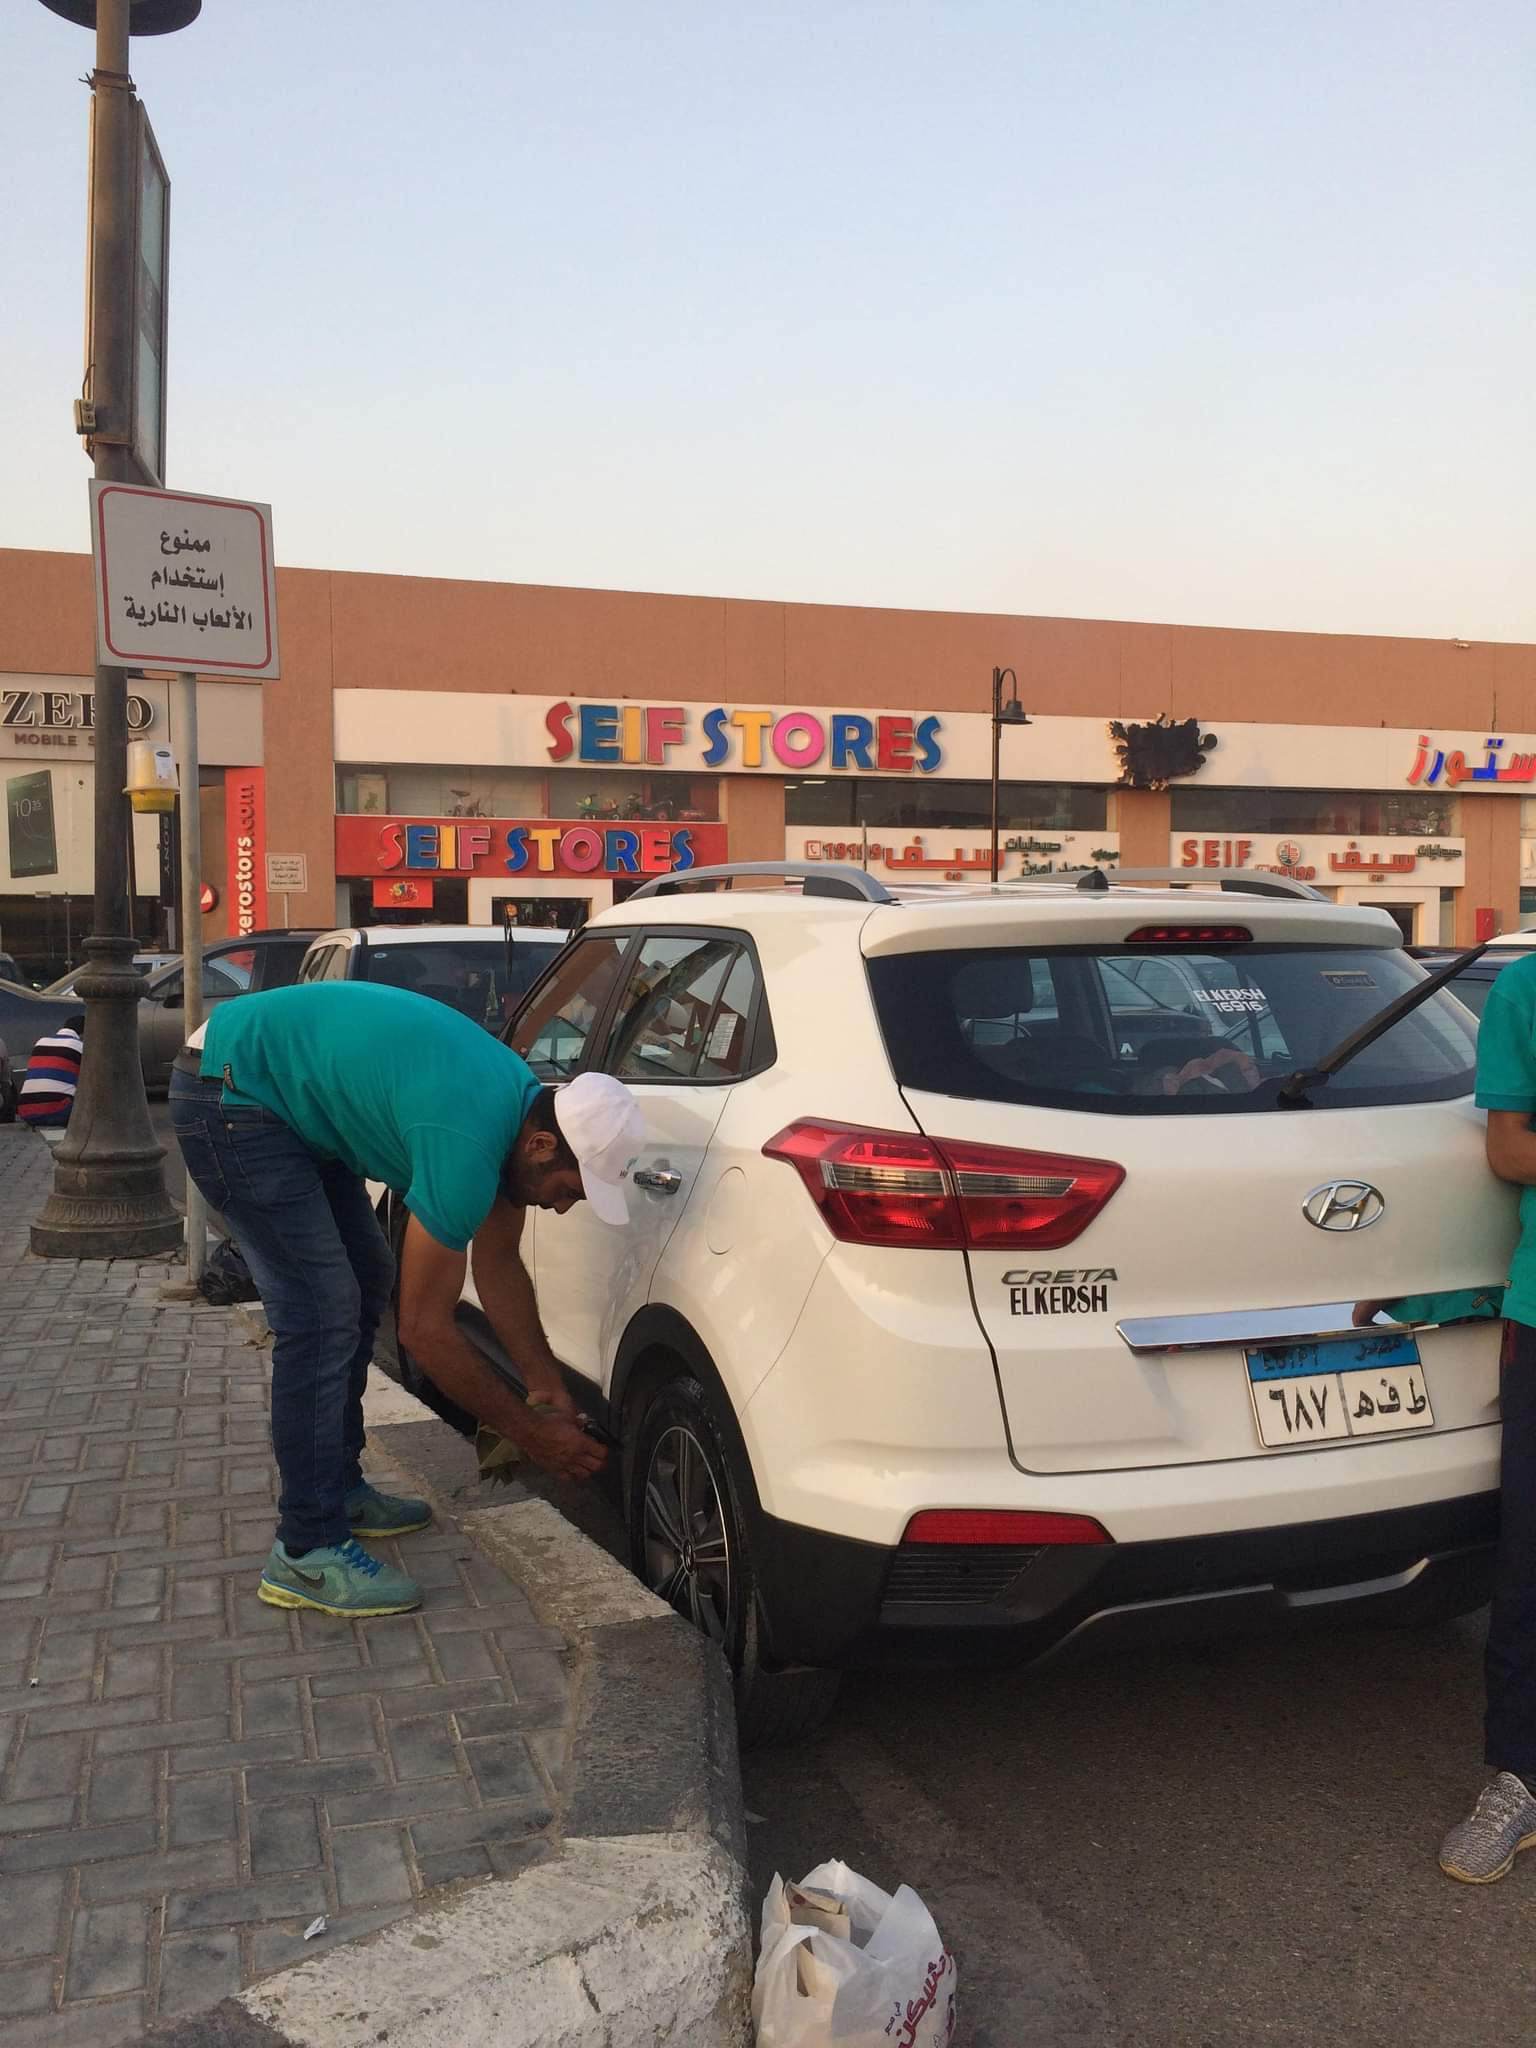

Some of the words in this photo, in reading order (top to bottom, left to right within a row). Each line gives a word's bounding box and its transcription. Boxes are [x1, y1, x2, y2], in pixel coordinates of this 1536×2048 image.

[160, 529, 211, 555] ممنوع
[151, 566, 225, 598] إستخدام
[123, 596, 187, 628] النارية
[192, 605, 253, 632] الألعاب
[14, 733, 77, 747] MOBILE
[546, 701, 686, 765] SEIF
[702, 707, 943, 774] STORES
[377, 823, 491, 871] SEIF
[504, 826, 695, 873] STORES
[885, 836, 1005, 881] سيف
[1182, 839, 1252, 868] SEIF
[1329, 841, 1416, 883] سيف
[1194, 988, 1266, 1002] ELKERSH
[1212, 1001, 1263, 1013] 16916
[1001, 1268, 1118, 1285] CRETA
[1010, 1284, 1107, 1315] ELKERSH
